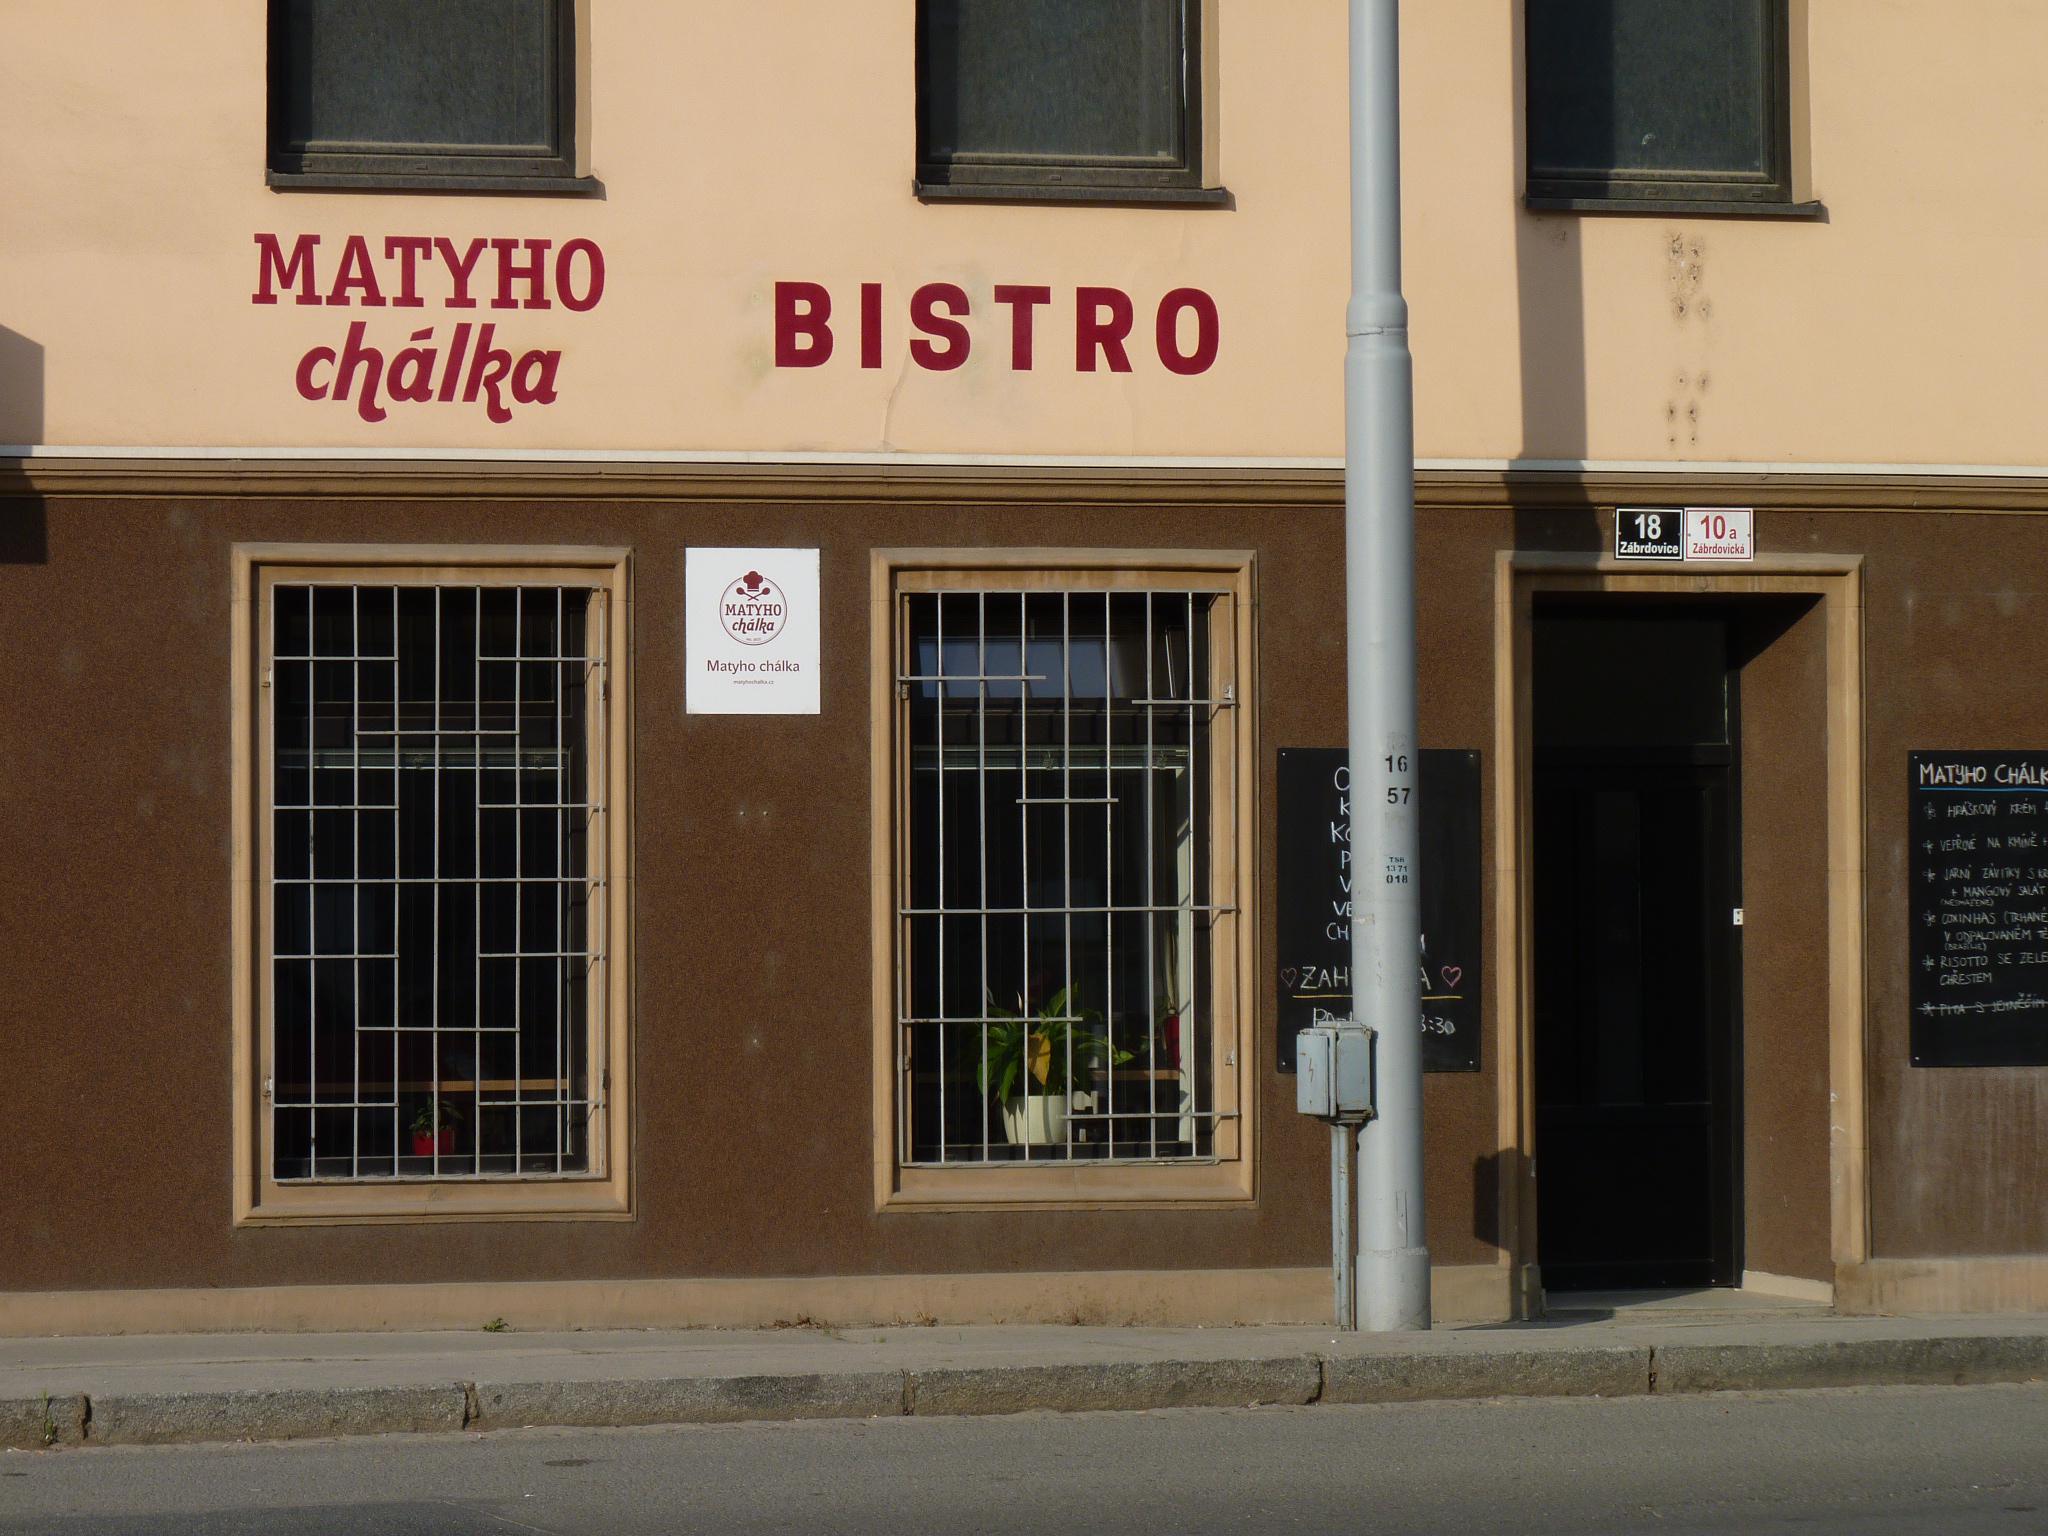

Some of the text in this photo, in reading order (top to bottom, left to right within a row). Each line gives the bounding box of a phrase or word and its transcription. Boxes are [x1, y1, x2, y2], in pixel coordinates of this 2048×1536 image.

[251, 233, 605, 313] MATYHO
[774, 281, 1220, 375] BISTRO
[295, 320, 561, 424] chálka
[1634, 513, 1662, 540] 18
[1700, 514, 1737, 540] 10 a
[1620, 541, 1679, 554] Zábrdovice
[1692, 542, 1745, 554] Zábrdovická
[725, 603, 782, 616] MATYHO
[732, 618, 774, 634] chálka
[706, 659, 800, 674] Matyho chálka
[1385, 754, 1408, 774] 16
[1919, 763, 1987, 785] MATYHO
[1387, 787, 1412, 805] 57
[2009, 797, 2037, 815] KRÉM
[1987, 836, 2001, 848] NA
[1386, 874, 1408, 884] 018
[1940, 955, 1988, 968] RISOTTO
[1997, 952, 2013, 964] SE
